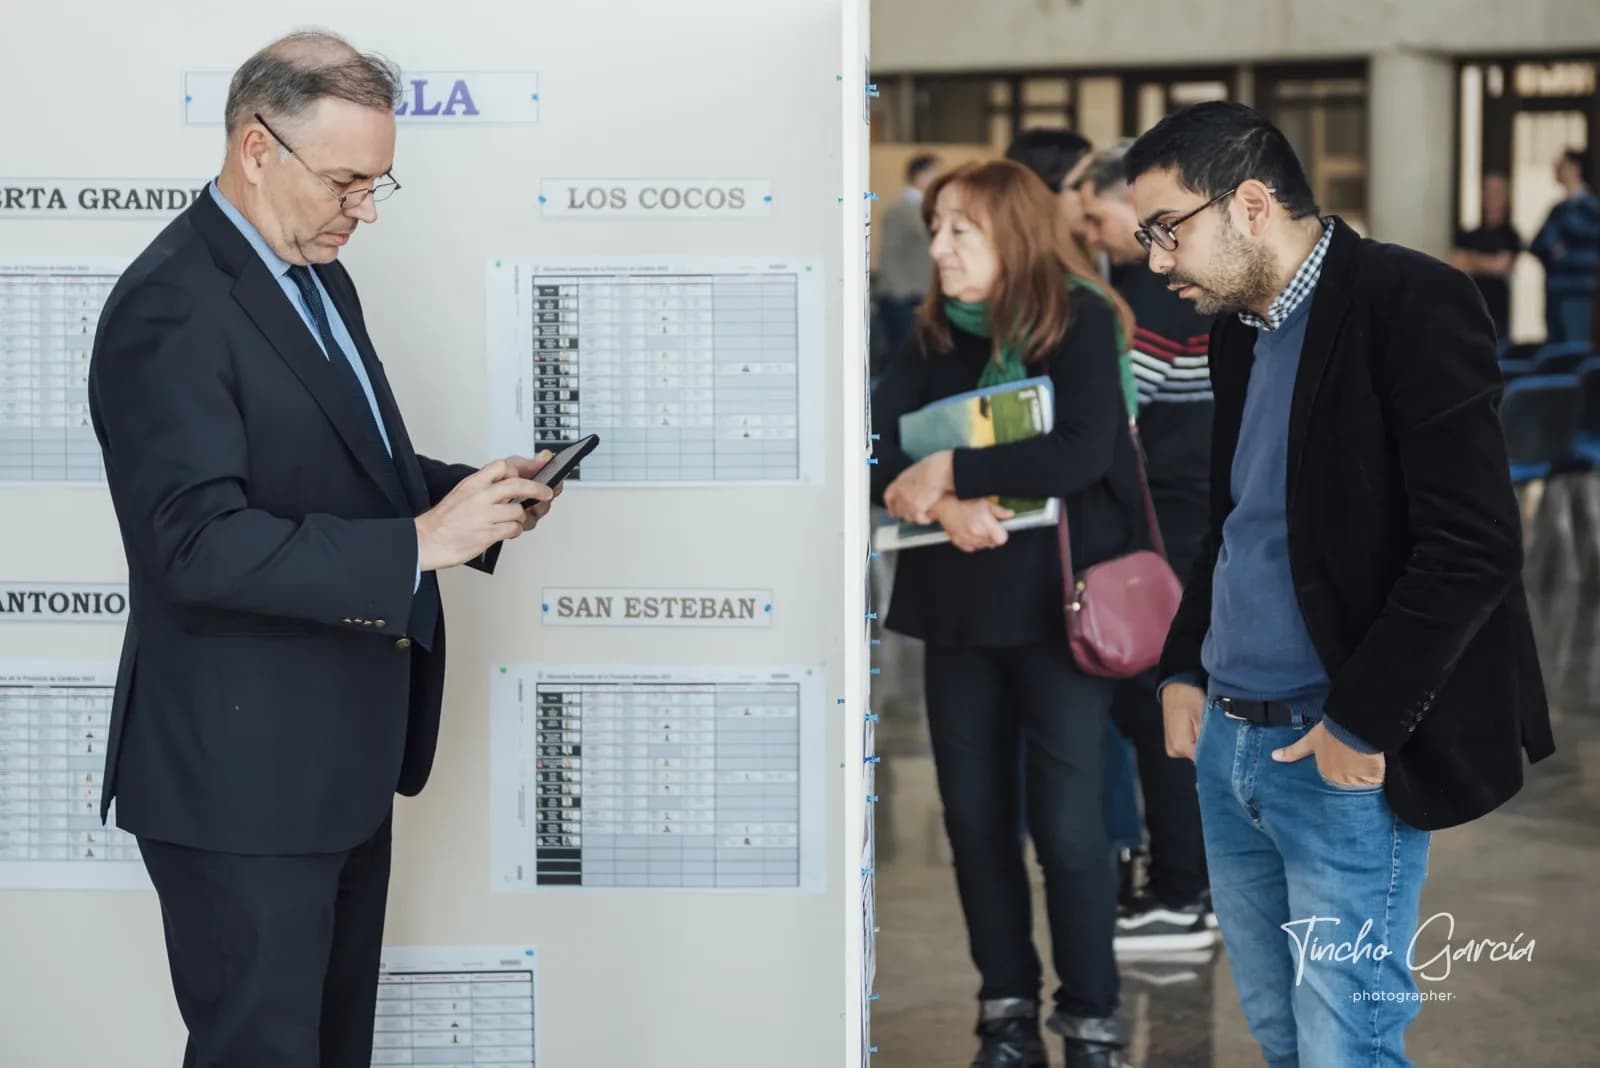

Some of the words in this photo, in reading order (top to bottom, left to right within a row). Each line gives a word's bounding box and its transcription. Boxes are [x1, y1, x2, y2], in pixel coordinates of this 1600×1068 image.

[0, 187, 67, 209] RTA
[567, 187, 627, 209] LOS
[638, 187, 745, 210] COCOS
[0, 591, 126, 614] NTONIO
[557, 596, 613, 618] SAN
[623, 597, 756, 619] ESTEBAN
